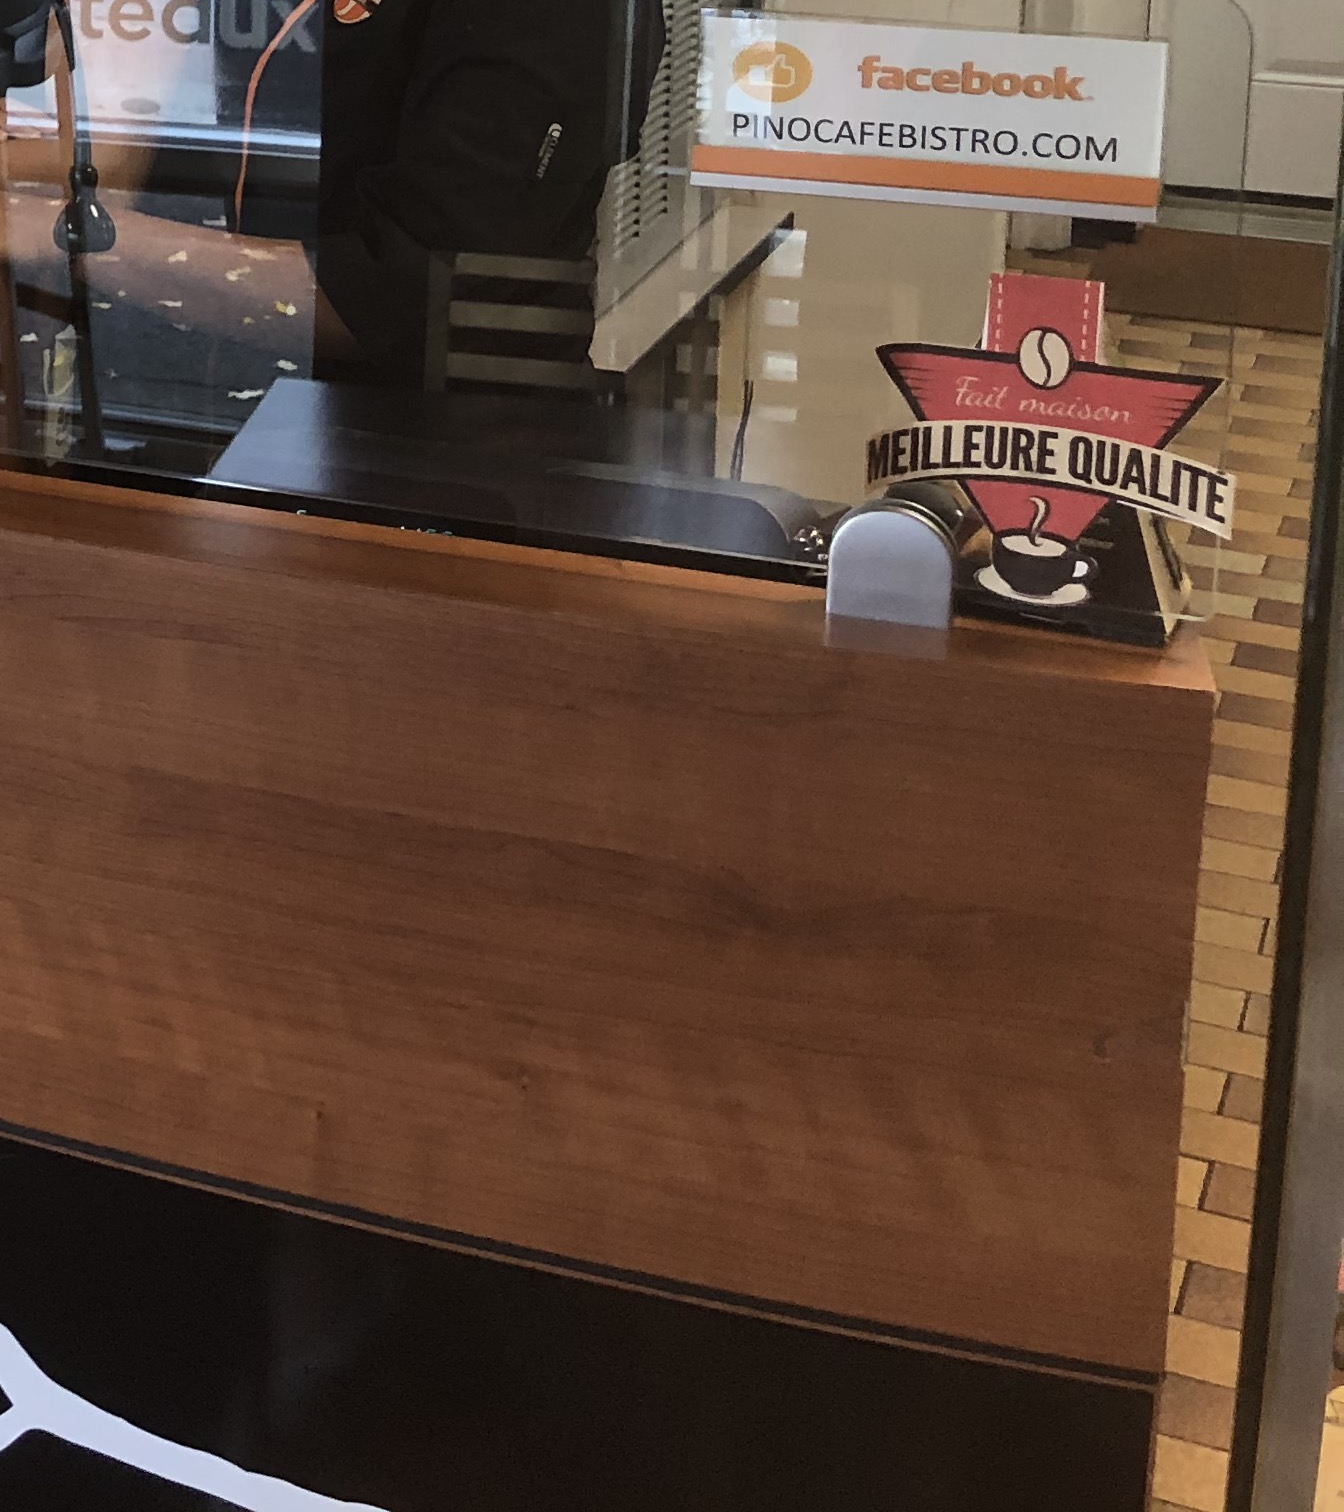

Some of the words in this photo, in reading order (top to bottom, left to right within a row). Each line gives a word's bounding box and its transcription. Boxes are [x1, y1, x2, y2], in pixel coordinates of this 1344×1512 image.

[856, 54, 1086, 101] facebook
[731, 112, 1119, 164] PINOCAFEBISTRO.COM
[954, 375, 1009, 412] Fait
[1017, 396, 1134, 426] maison
[867, 424, 1059, 485] MEILLEURE
